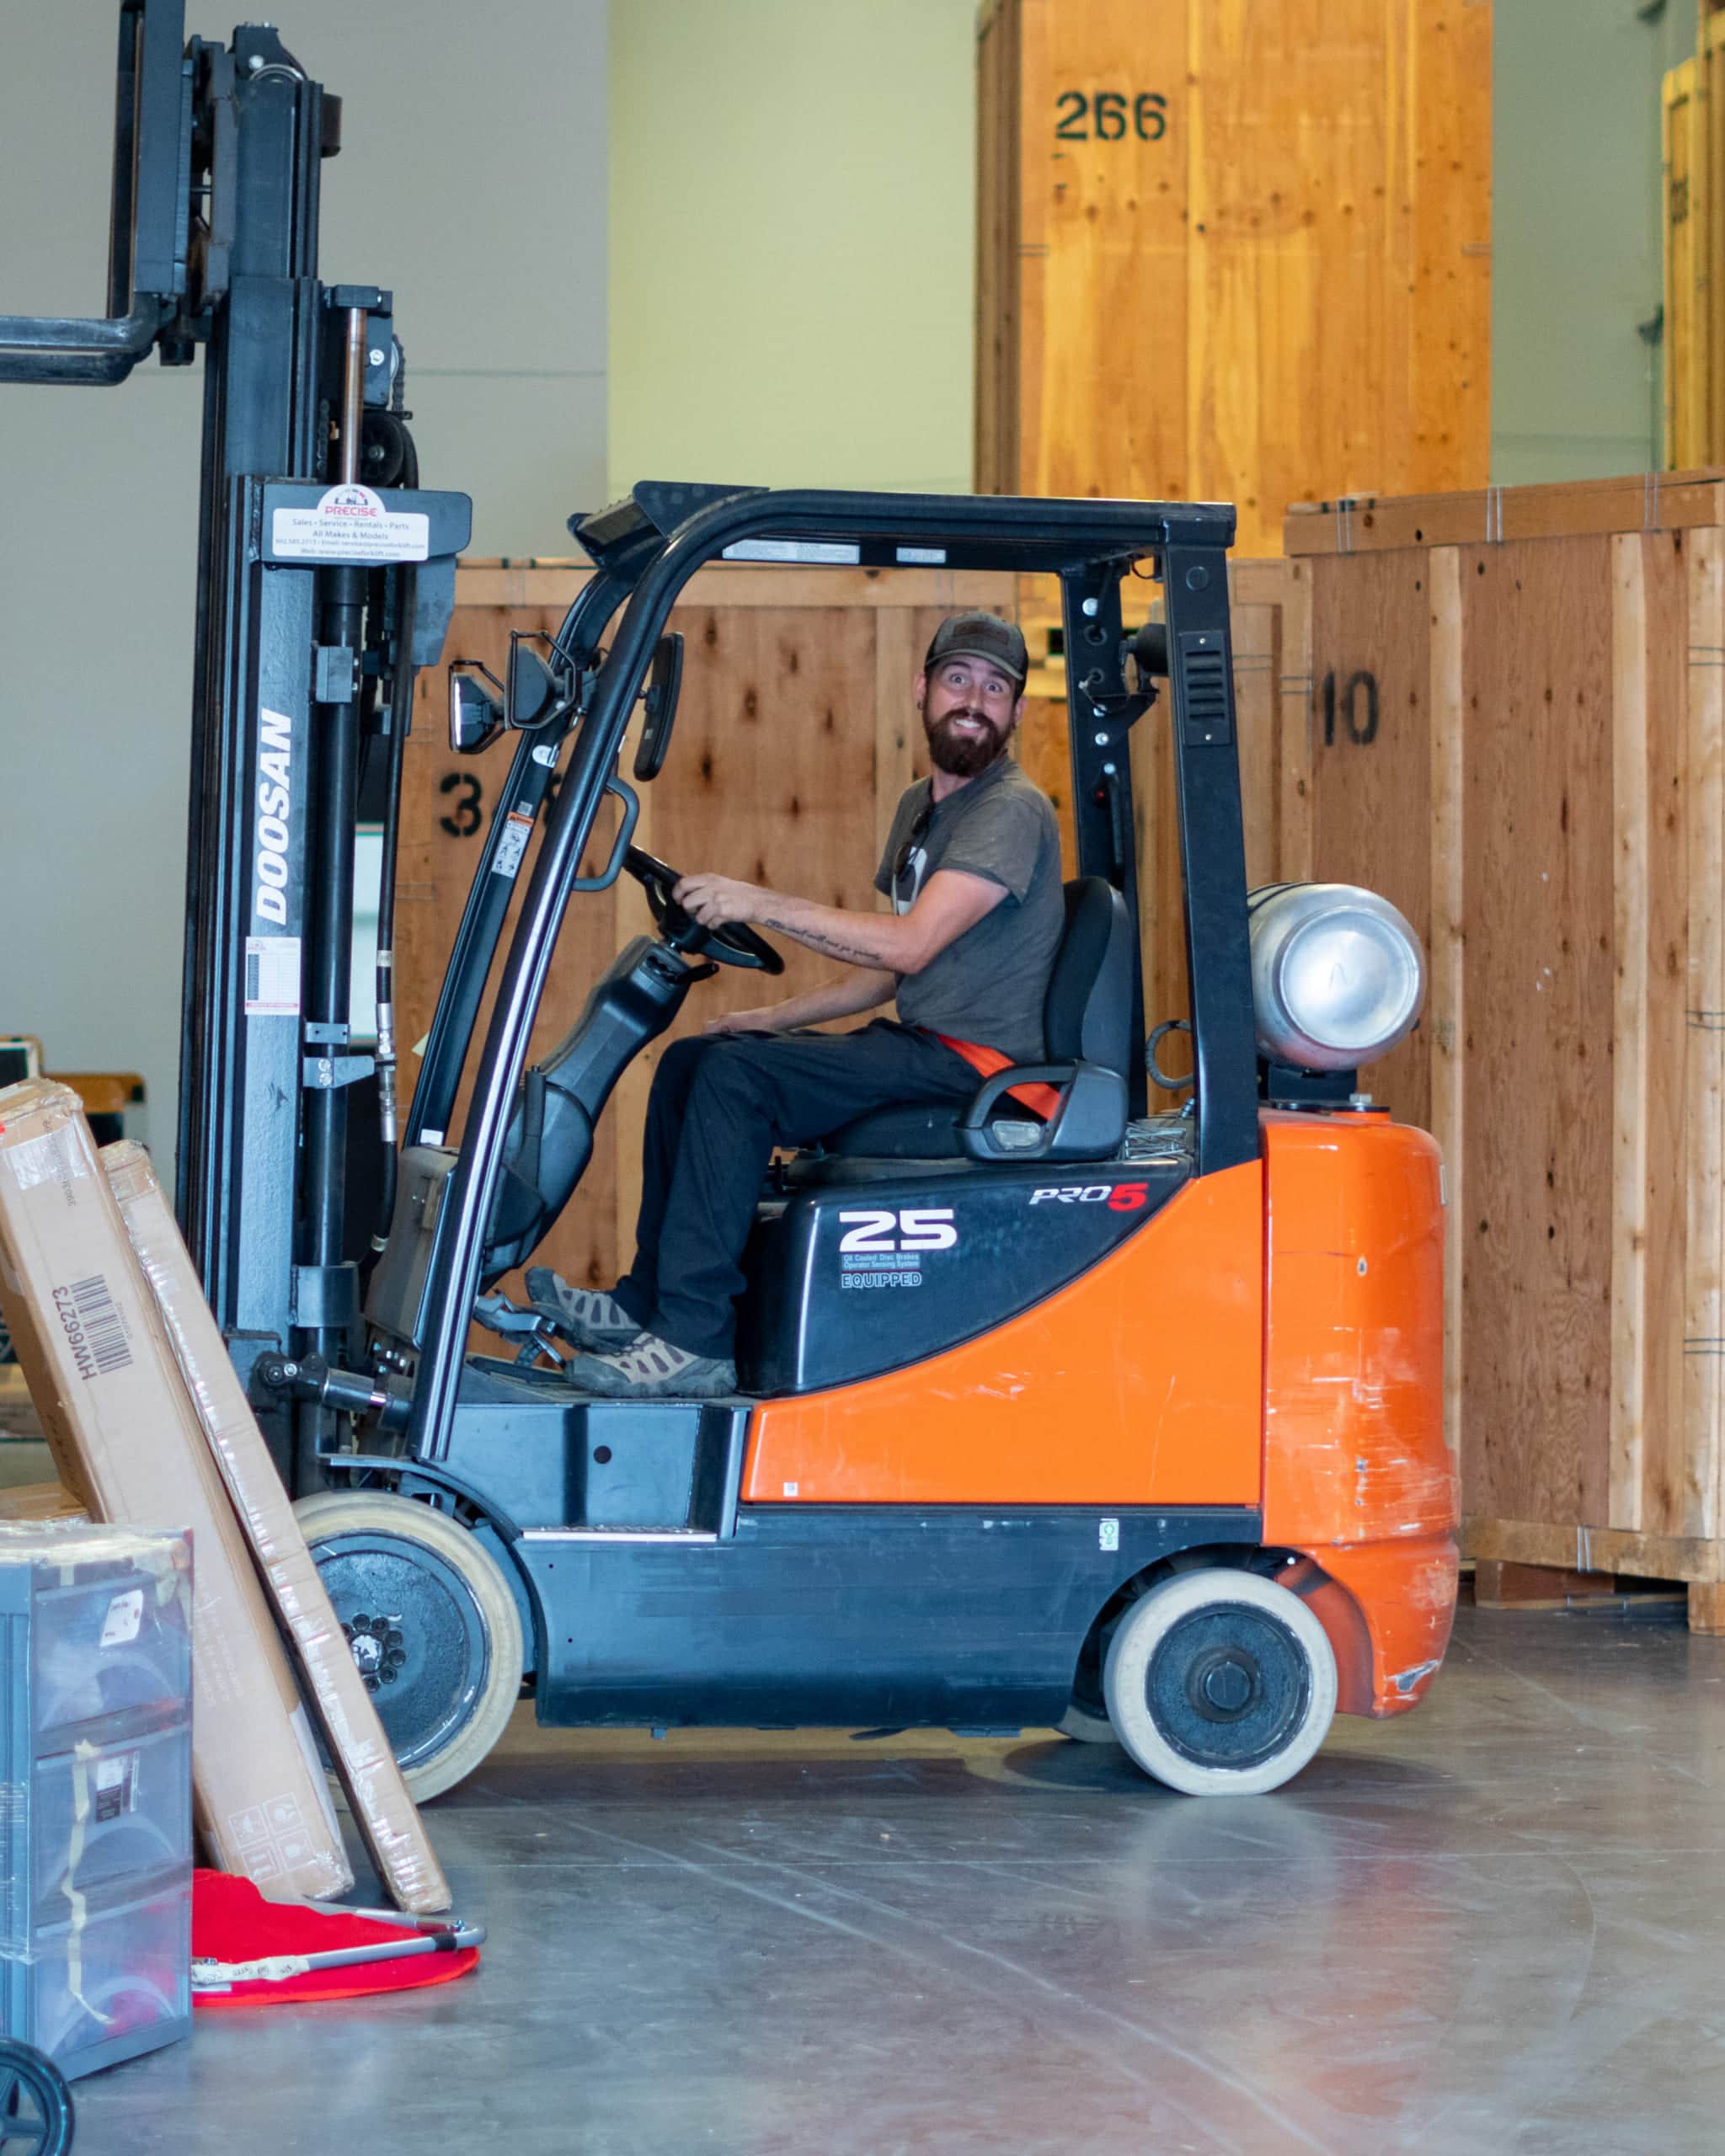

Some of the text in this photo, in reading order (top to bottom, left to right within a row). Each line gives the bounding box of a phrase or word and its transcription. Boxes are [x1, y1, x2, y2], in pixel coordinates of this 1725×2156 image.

[1055, 91, 1167, 141] 266
[291, 518, 410, 530] Sales Service Rentals Parts
[324, 506, 377, 516] PRECISE
[360, 531, 389, 540] Models
[1323, 670, 1379, 747] 10
[255, 707, 291, 926] DOOSAN
[839, 1209, 958, 1252] 25
[841, 1272, 922, 1289] EQUIPPED
[51, 1285, 98, 1380] HW66273
